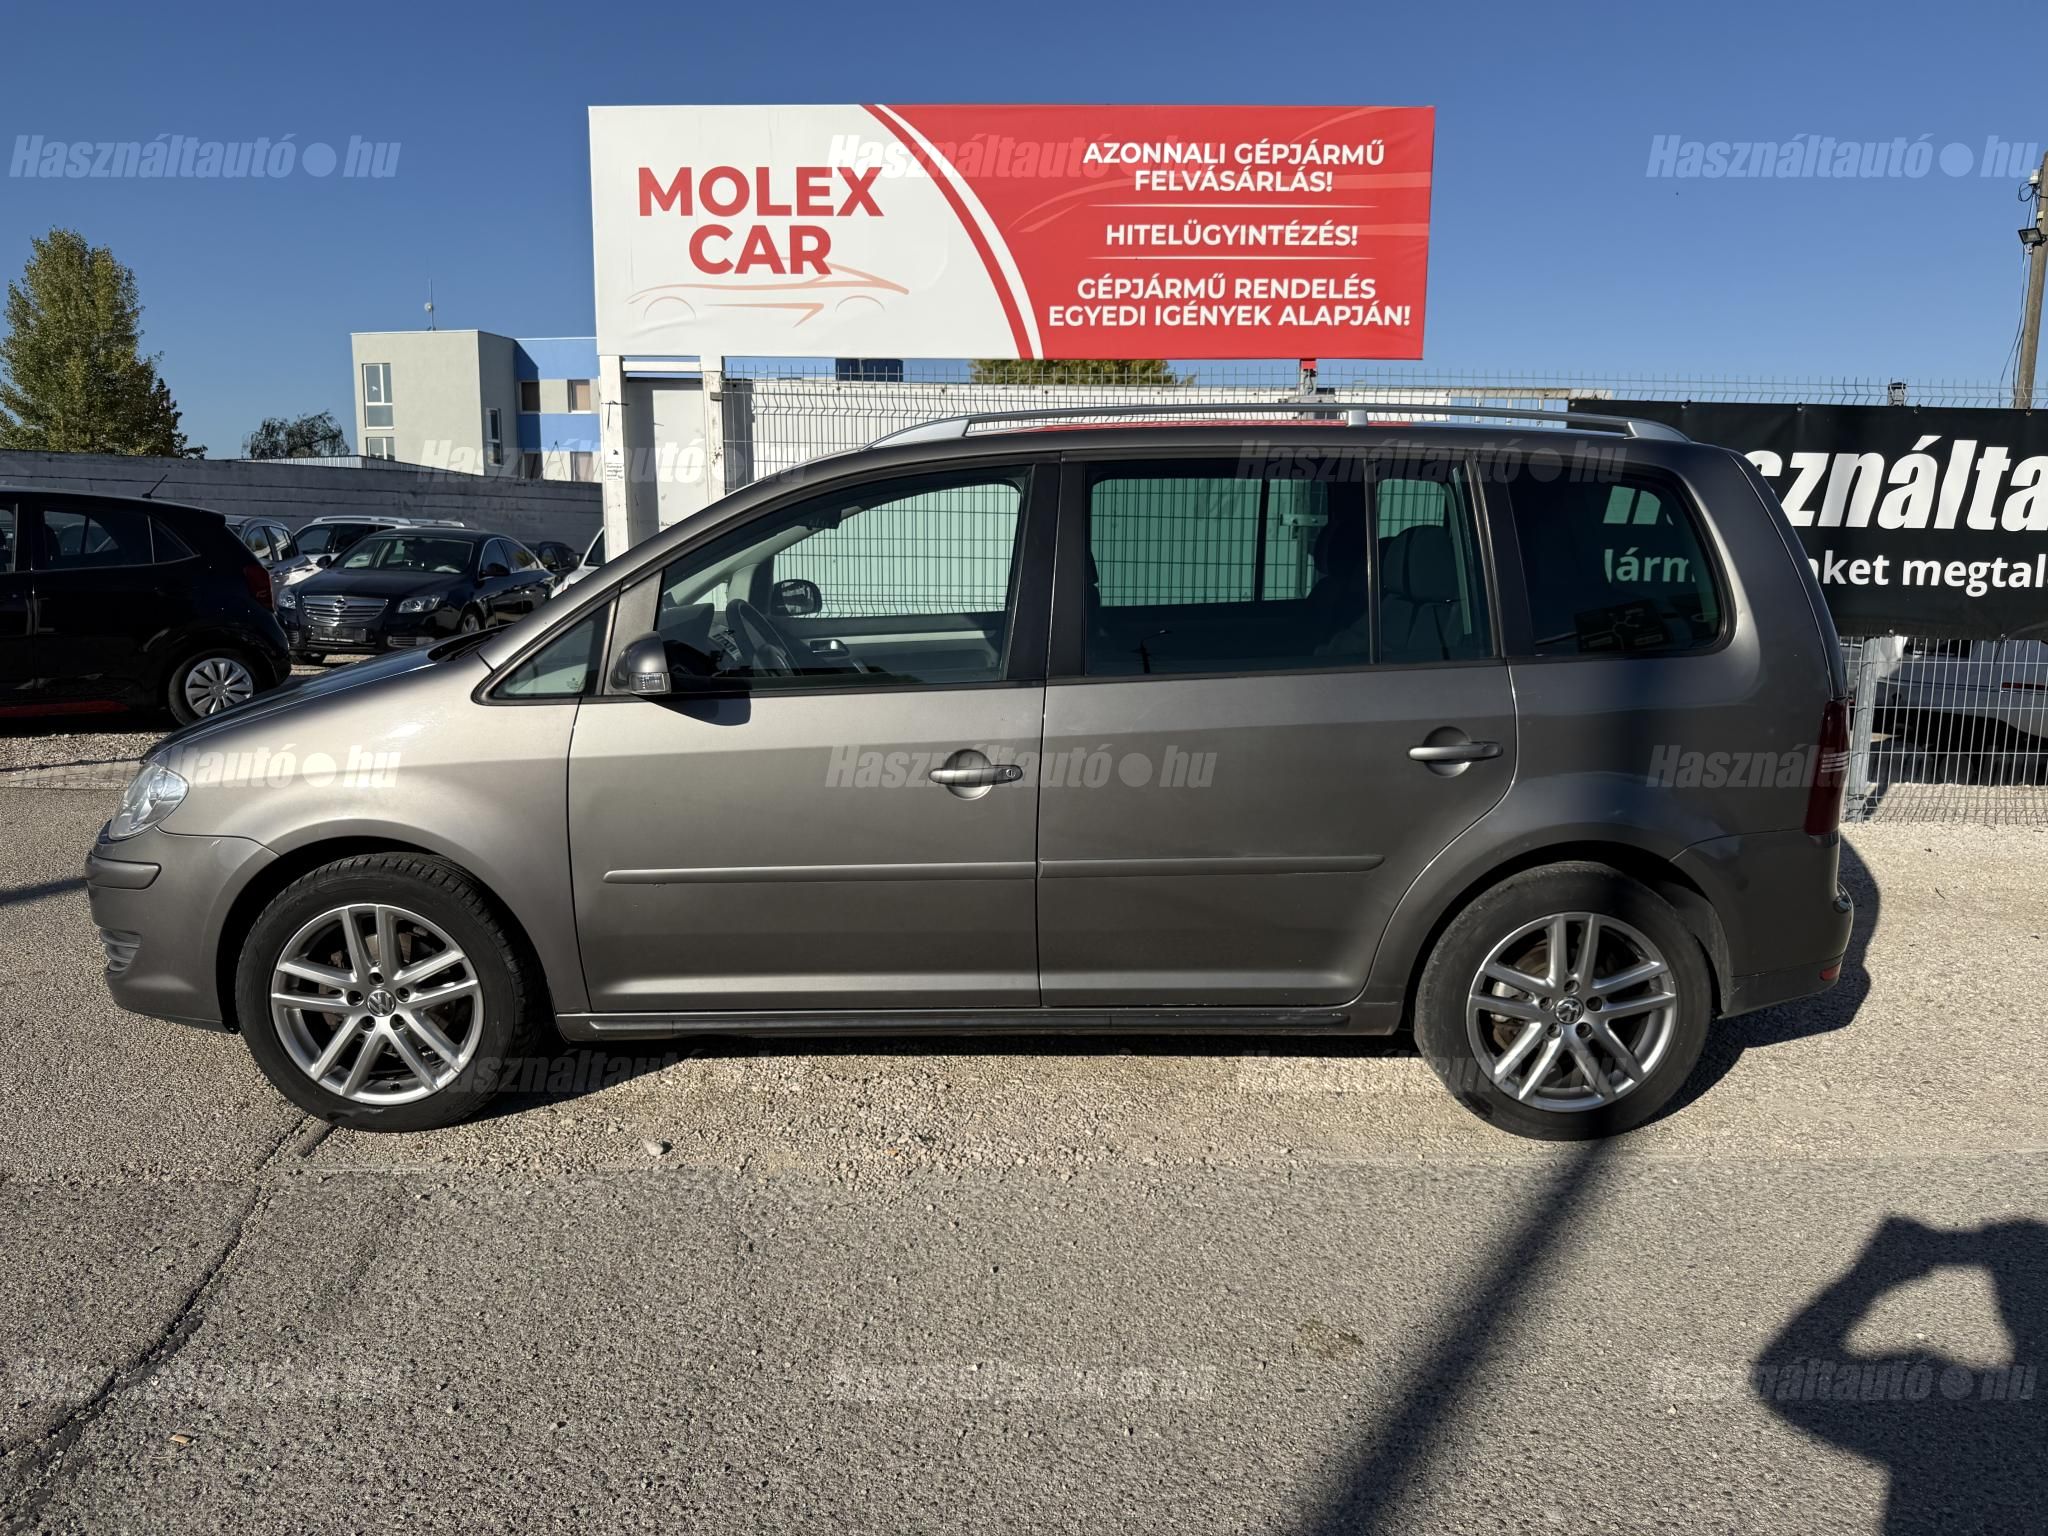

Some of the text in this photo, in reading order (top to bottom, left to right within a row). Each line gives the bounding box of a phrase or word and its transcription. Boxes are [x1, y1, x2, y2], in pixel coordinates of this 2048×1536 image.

[1083, 138, 1385, 166] AZONNALI GÉPJÁRMŰ
[638, 166, 884, 217] MOLEX
[1135, 166, 1333, 192] FELVÁSÁRLÁS!
[1106, 219, 1358, 247] HITELÜGYINTÉZÉS!
[689, 224, 832, 275] CAR
[1077, 272, 1376, 300] GÉPJÁRMŰ RENDELÉS
[1049, 299, 1410, 327] EGYEDI IGÉNYEK ALAPJÁN!
